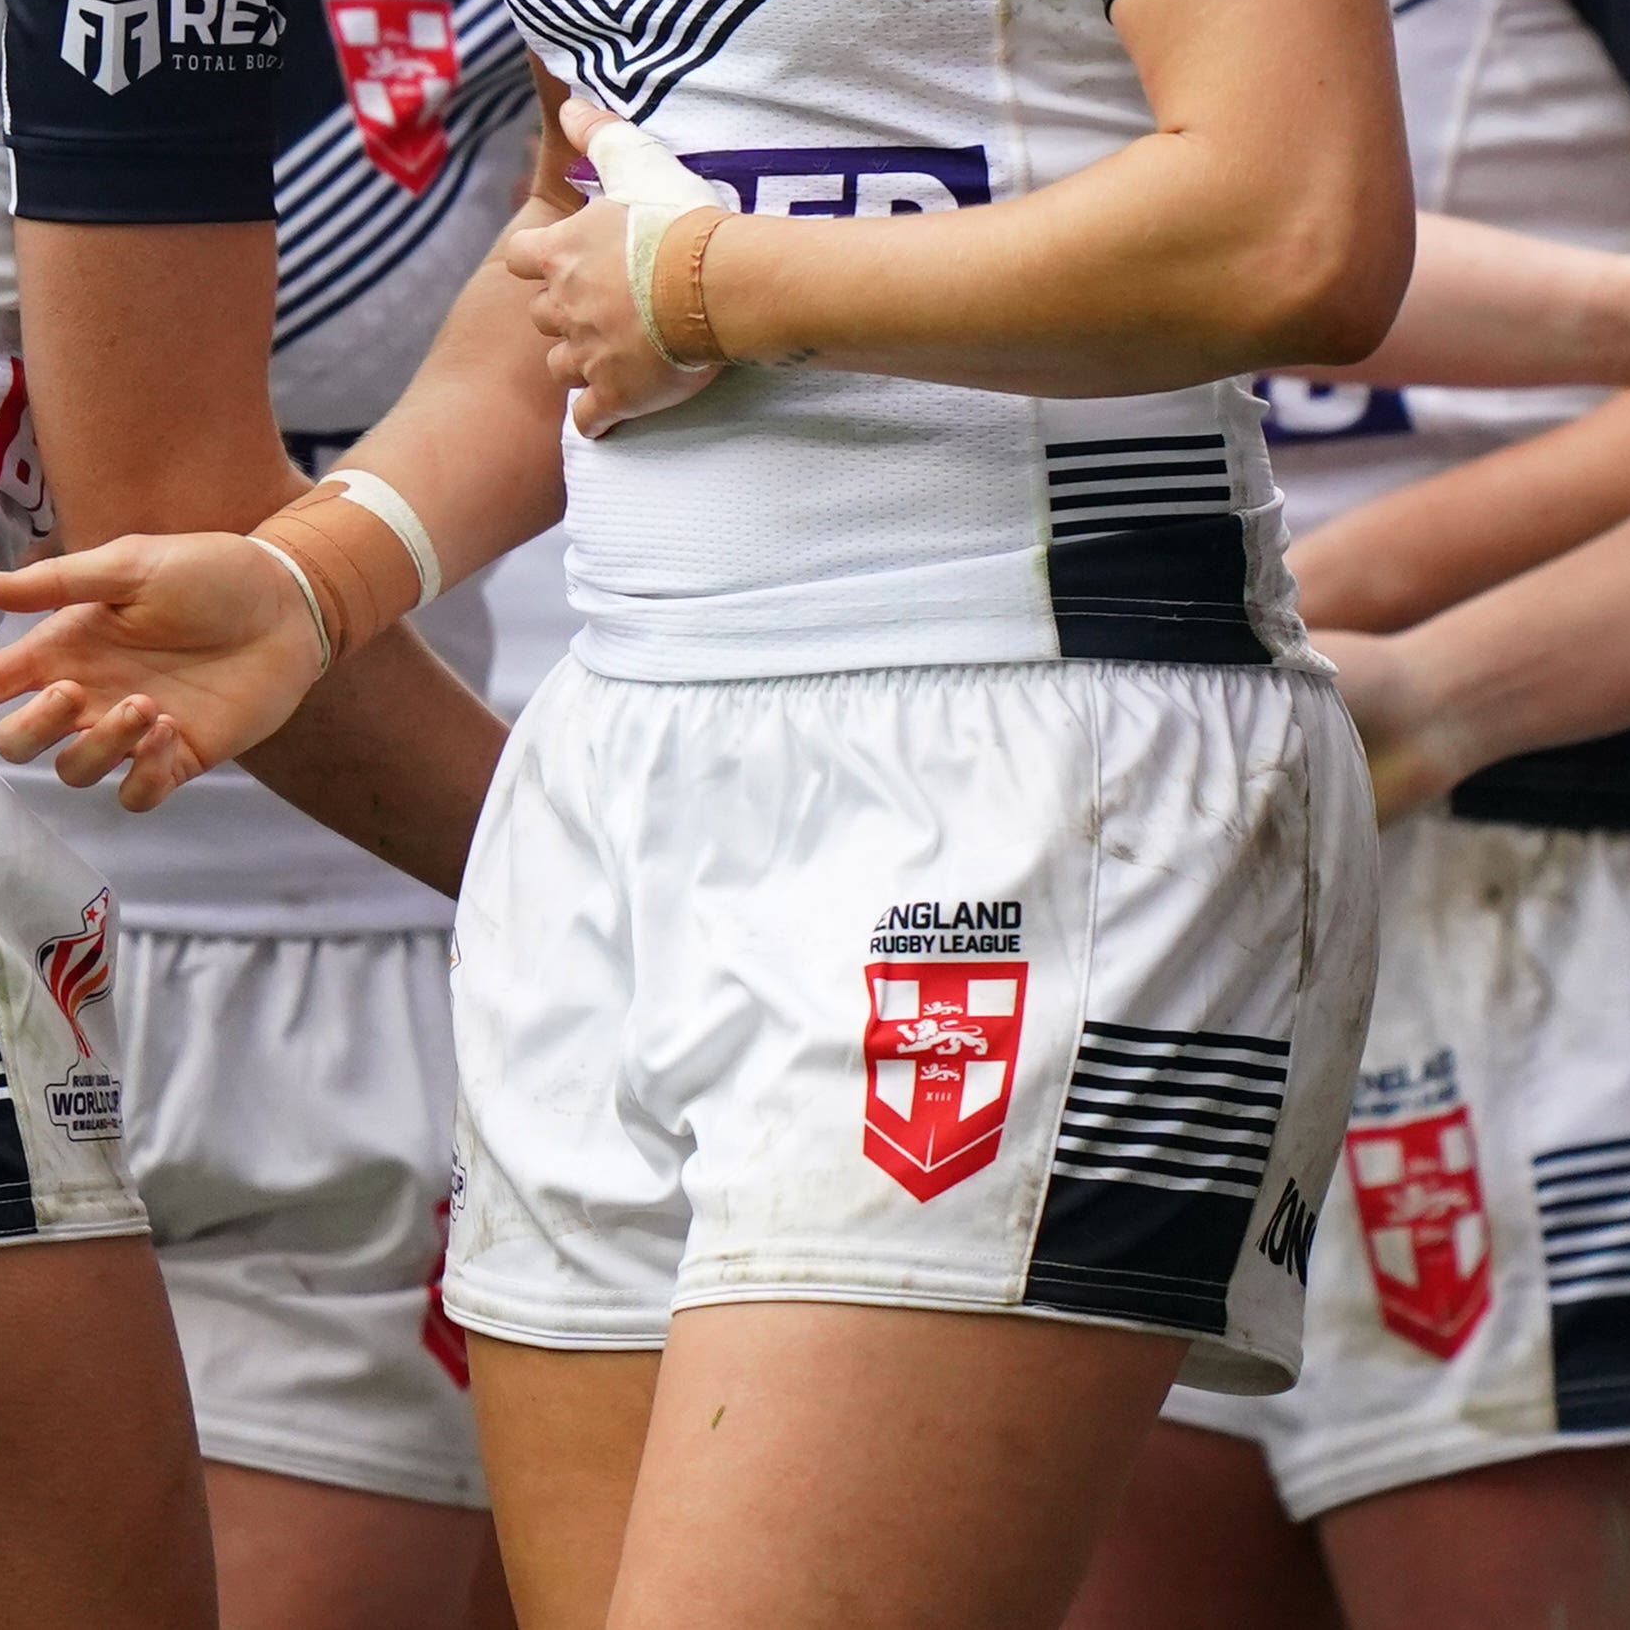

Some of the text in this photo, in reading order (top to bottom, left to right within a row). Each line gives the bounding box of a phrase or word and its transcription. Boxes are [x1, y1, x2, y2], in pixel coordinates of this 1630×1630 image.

[172, 54, 236, 71] TOTAL
[872, 901, 1022, 933] ENGLAND
[870, 935, 1021, 954] RUGBY LEAGUE
[925, 1092, 952, 1102] XIII
